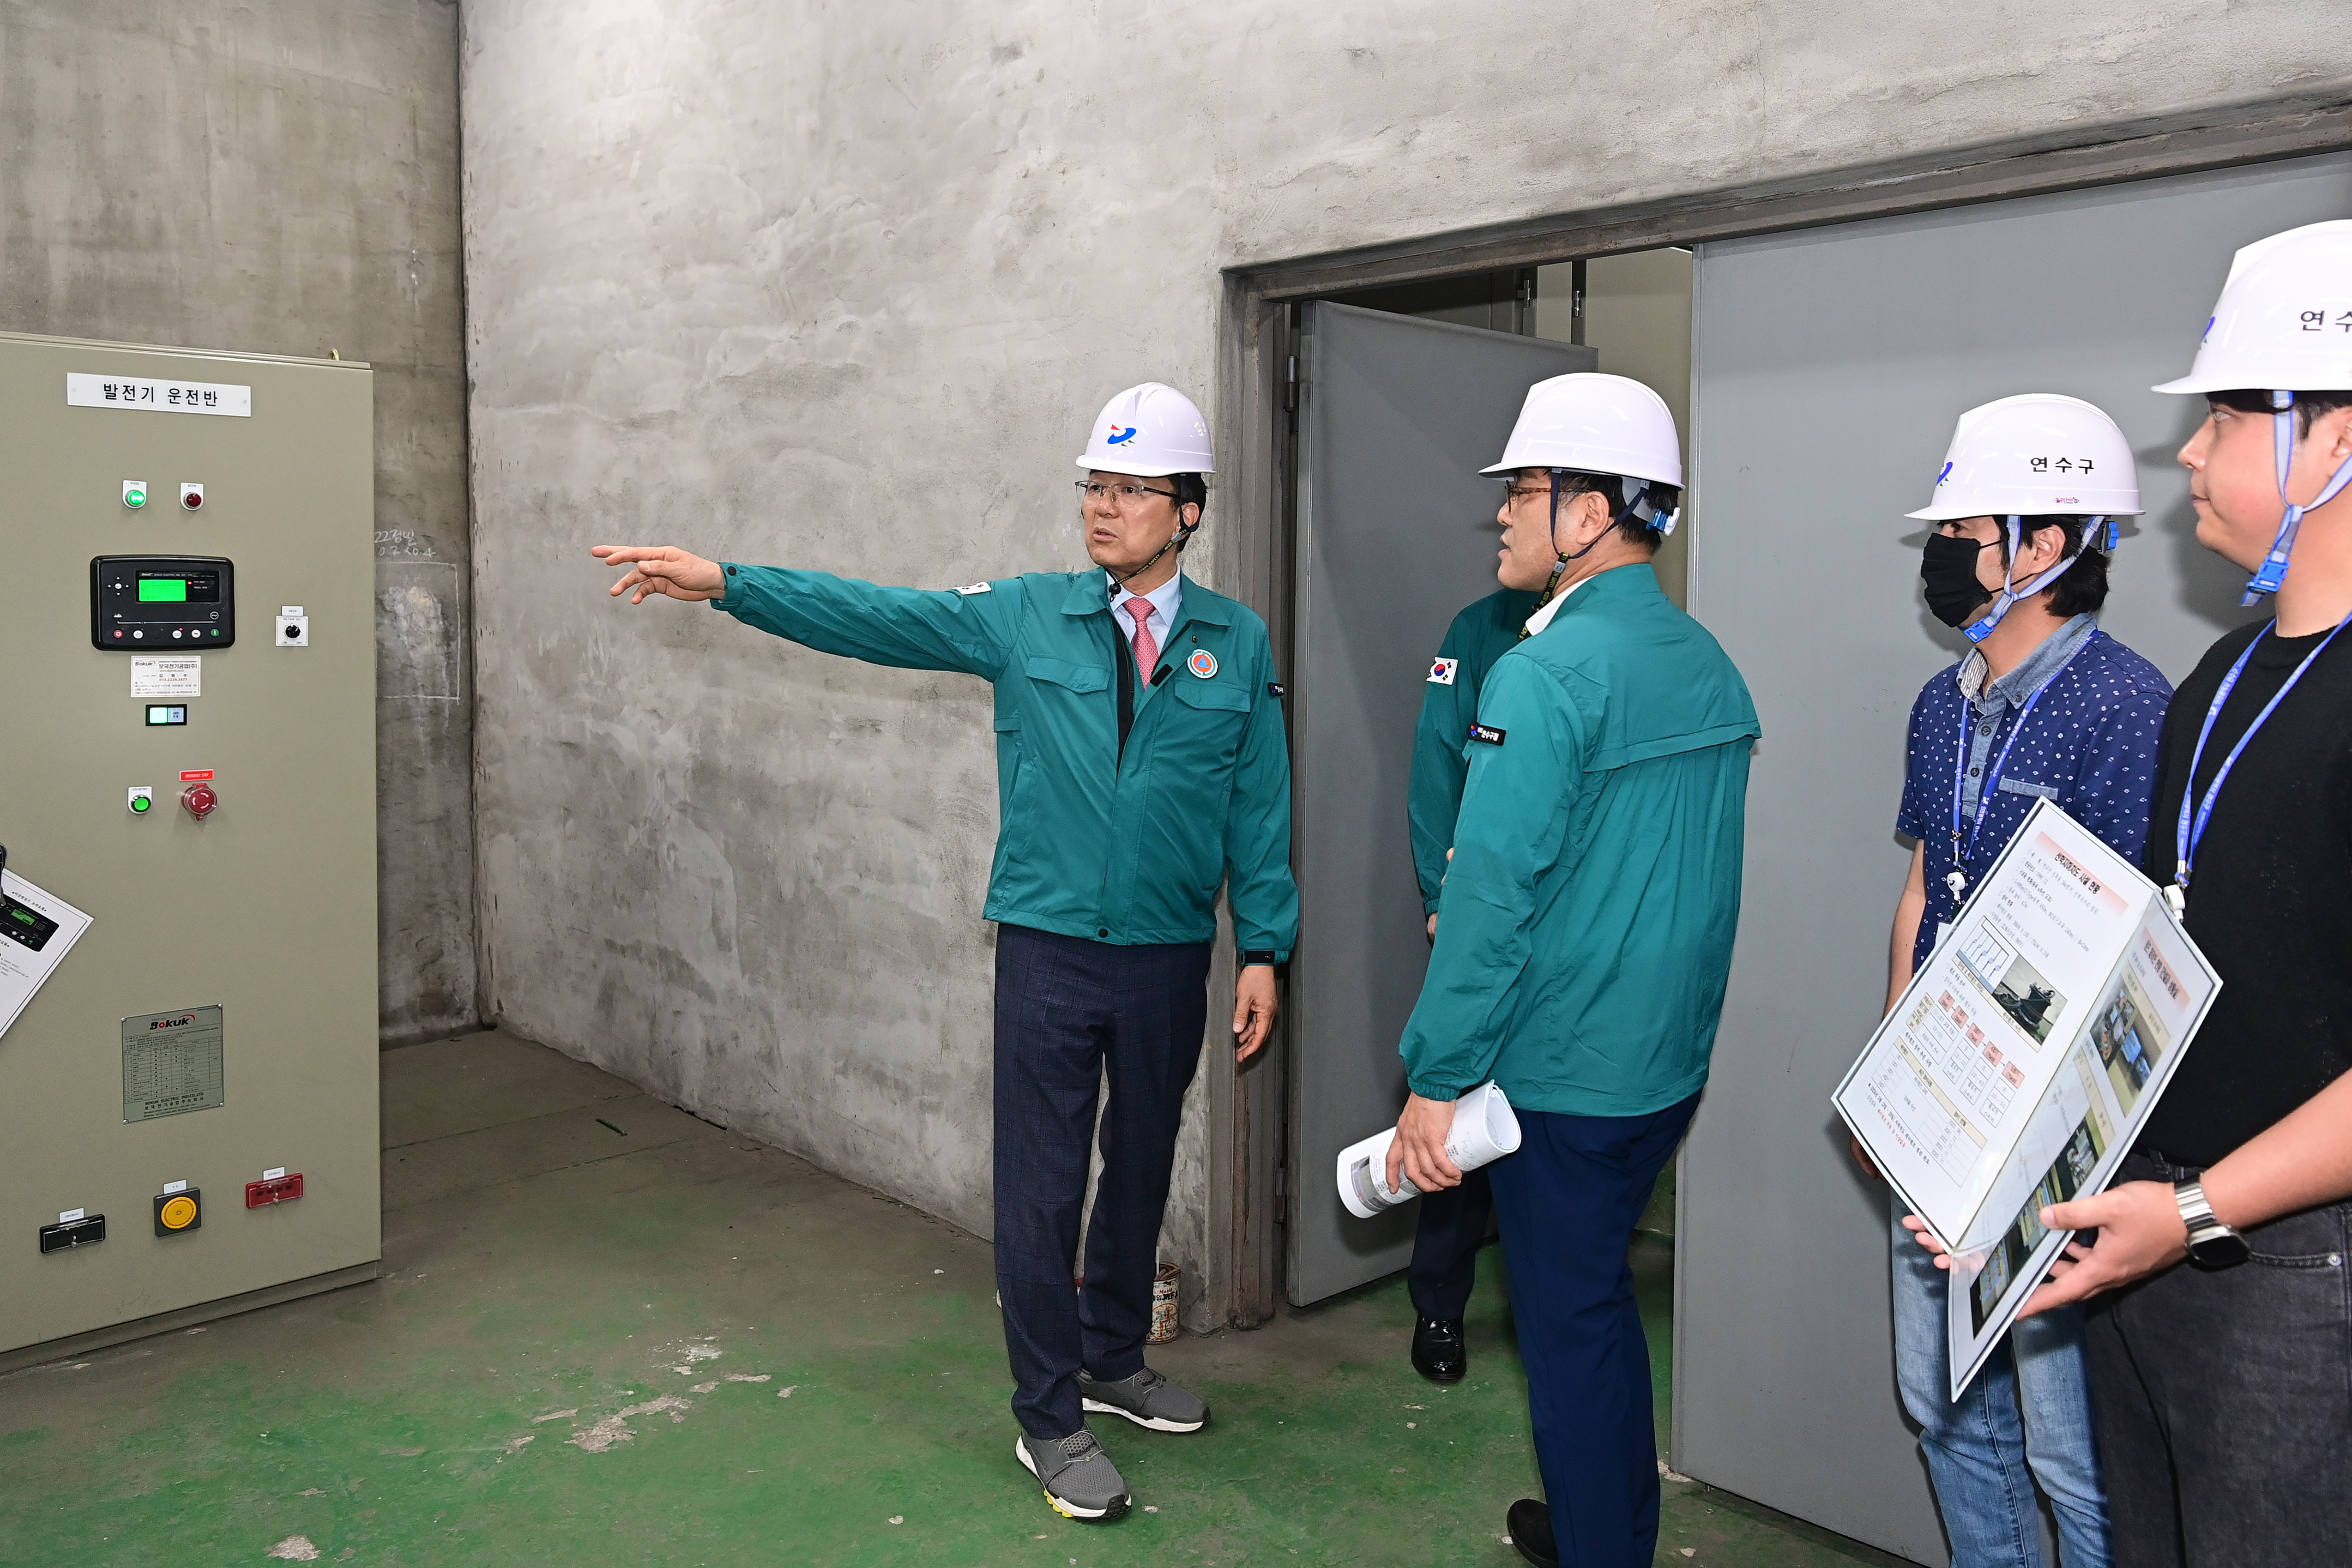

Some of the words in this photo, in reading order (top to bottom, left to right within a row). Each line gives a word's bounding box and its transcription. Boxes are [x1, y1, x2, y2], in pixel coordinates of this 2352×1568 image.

[103, 383, 154, 403] 발전기
[167, 388, 217, 407] 운전반
[2031, 457, 2094, 474] 연수구
[1148, 555, 1160, 566] SAFETY
[2213, 681, 2231, 706] 인천광역시
[2226, 666, 2240, 684] 연수구
[2010, 718, 2024, 737] 인천광역시
[2004, 736, 2013, 750] 연수구
[2201, 792, 2215, 810] 연수구
[1976, 805, 1986, 825] 인천광역시
[2180, 819, 2189, 835] 연수구
[2053, 851, 2081, 878] 선학지하차도
[2078, 871, 2091, 886] 시설
[2088, 880, 2101, 895] 현황
[150, 1017, 190, 1030] Bokuk
